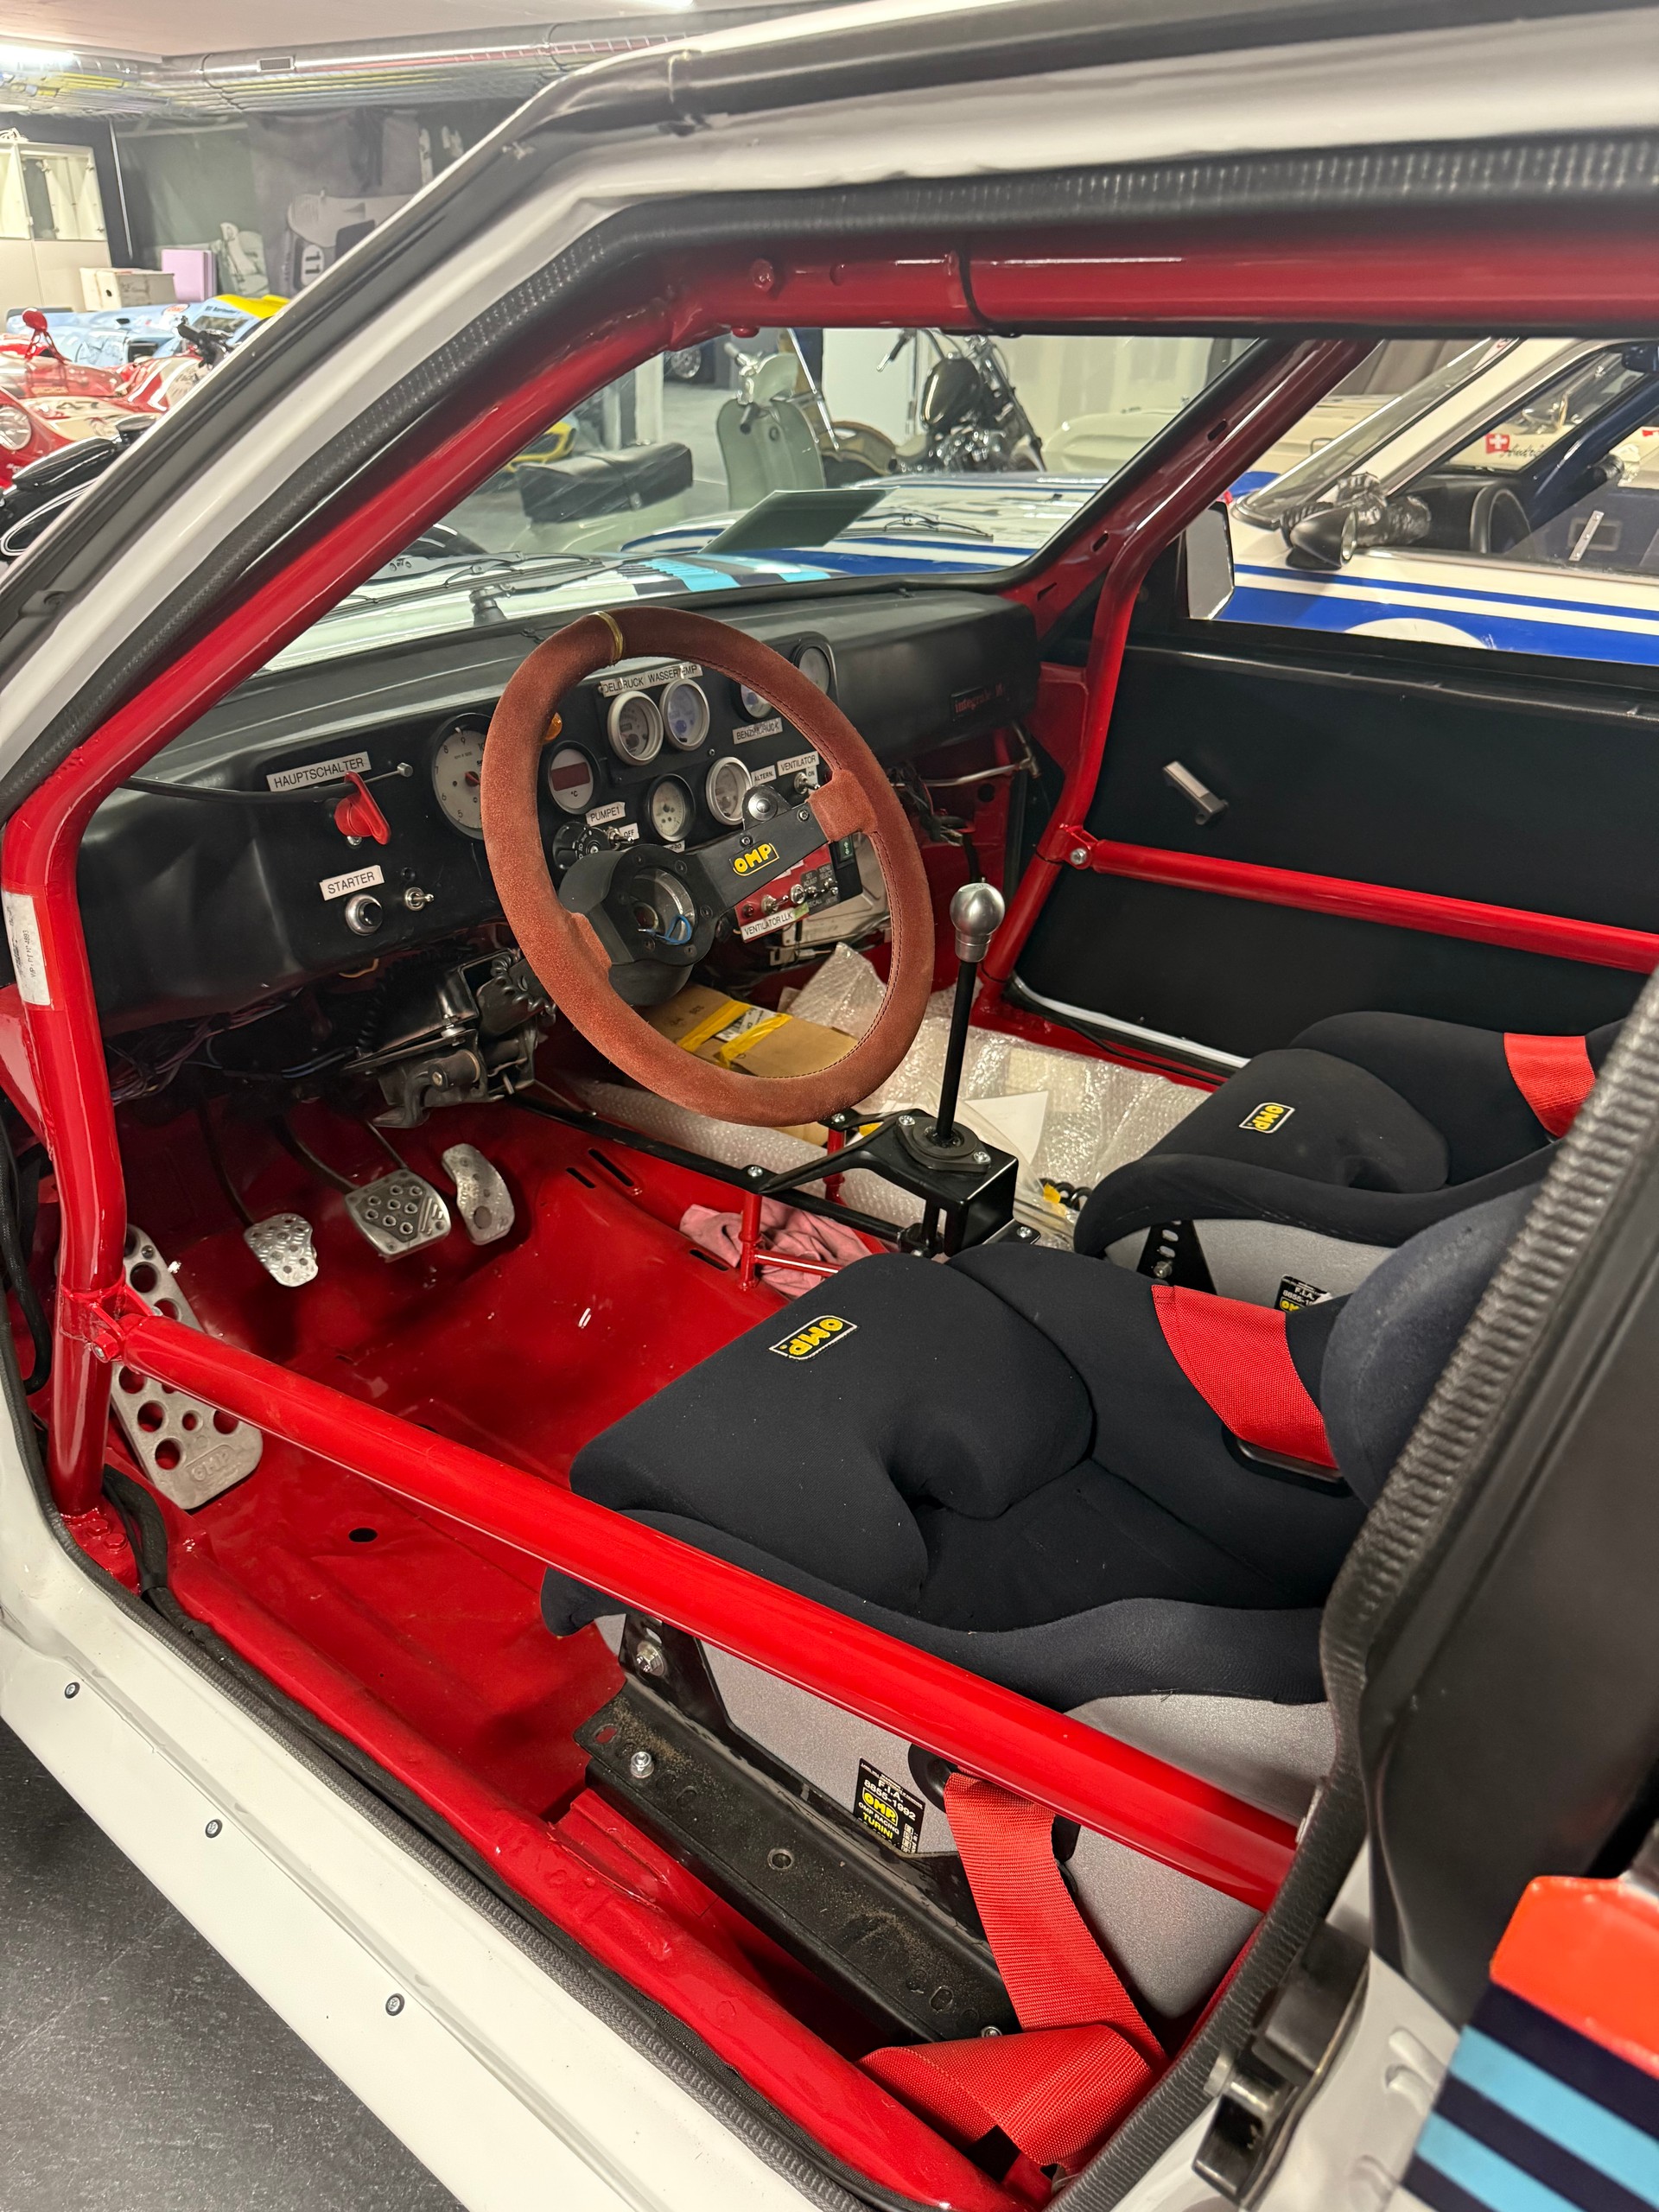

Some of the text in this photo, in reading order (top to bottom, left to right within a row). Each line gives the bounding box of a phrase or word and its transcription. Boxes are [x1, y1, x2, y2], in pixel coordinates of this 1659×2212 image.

[274, 758, 365, 788] HAUPTSCHALTER
[781, 755, 817, 772] VENTILATOR
[590, 806, 620, 822] PUMPE1
[624, 829, 635, 839] OFF
[734, 843, 772, 873] OMP
[327, 871, 375, 894] STARTER
[744, 911, 793, 936] VENTILATOR LLK
[1251, 1105, 1284, 1130] OMP
[1281, 1300, 1300, 1312] OM
[1295, 1287, 1315, 1300] F.I.A.
[789, 1318, 843, 1356] OMP
[864, 1779, 916, 1821] 8855-1992
[878, 1779, 904, 1802] F.I.A.
[858, 1802, 874, 1815] OMP
[874, 1812, 900, 1835] RACING
[864, 1792, 897, 1822] OMP
[862, 1812, 893, 1840] TURINI
